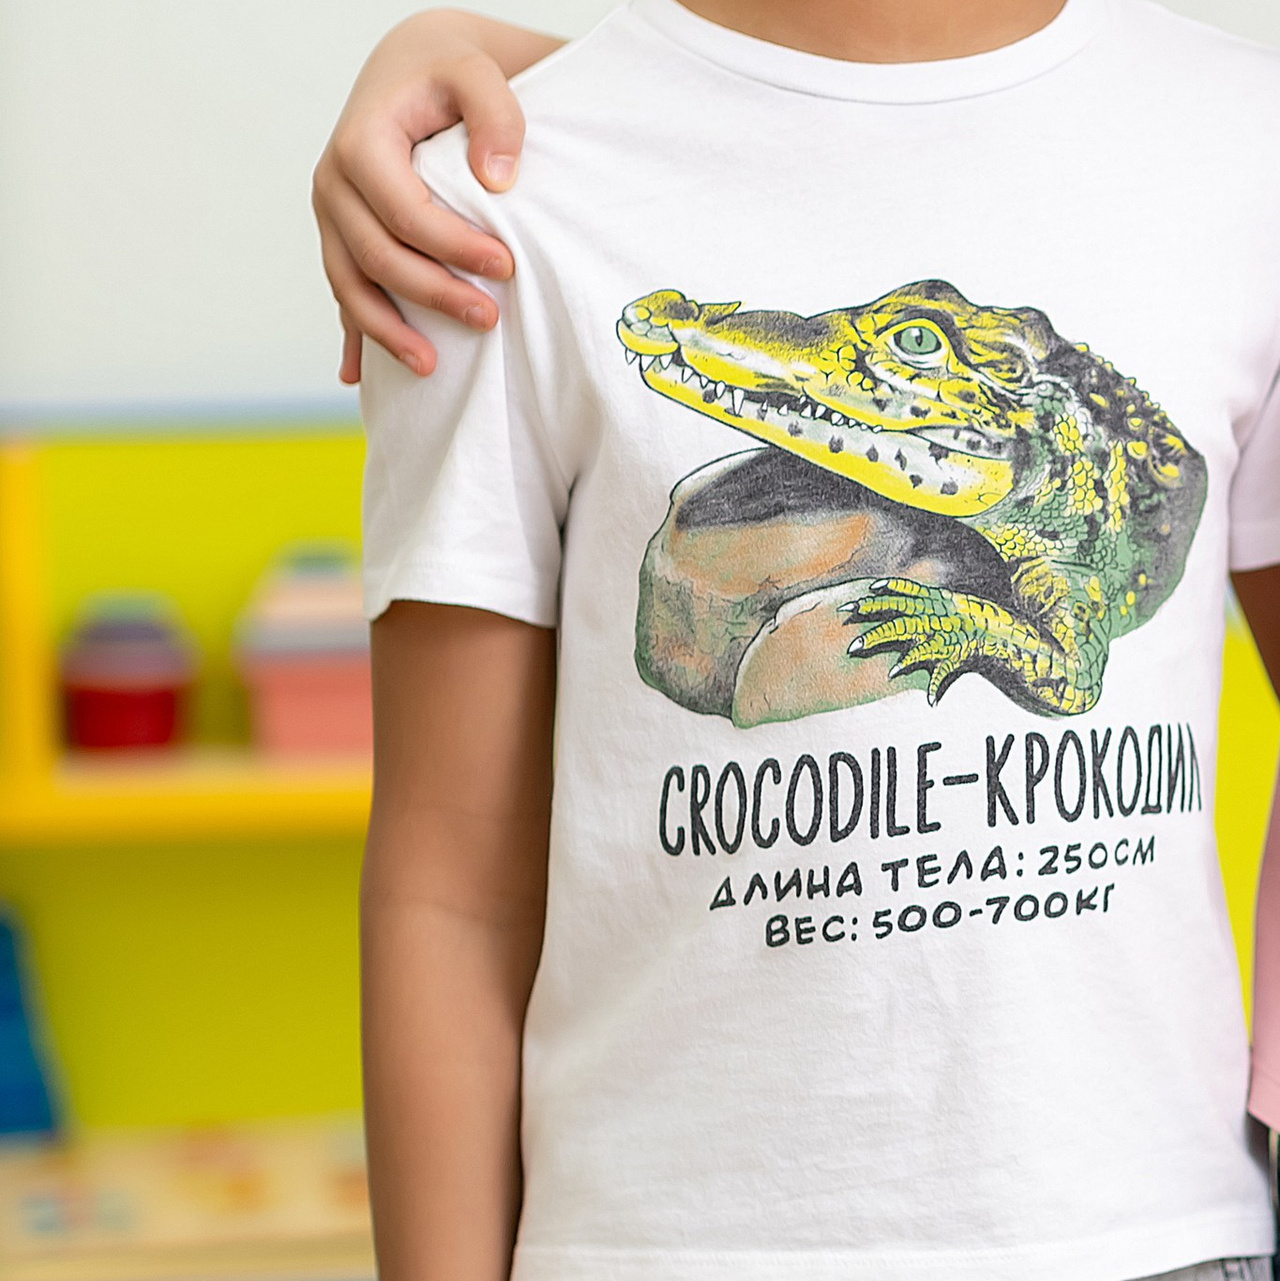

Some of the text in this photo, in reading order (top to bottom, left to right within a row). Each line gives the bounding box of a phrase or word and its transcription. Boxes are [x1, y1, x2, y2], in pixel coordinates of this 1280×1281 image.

[709, 862, 864, 912] ДЛИНА
[880, 850, 1026, 892] ТЕЛА:
[763, 883, 1117, 950] ВЕС: 500-700КГ
